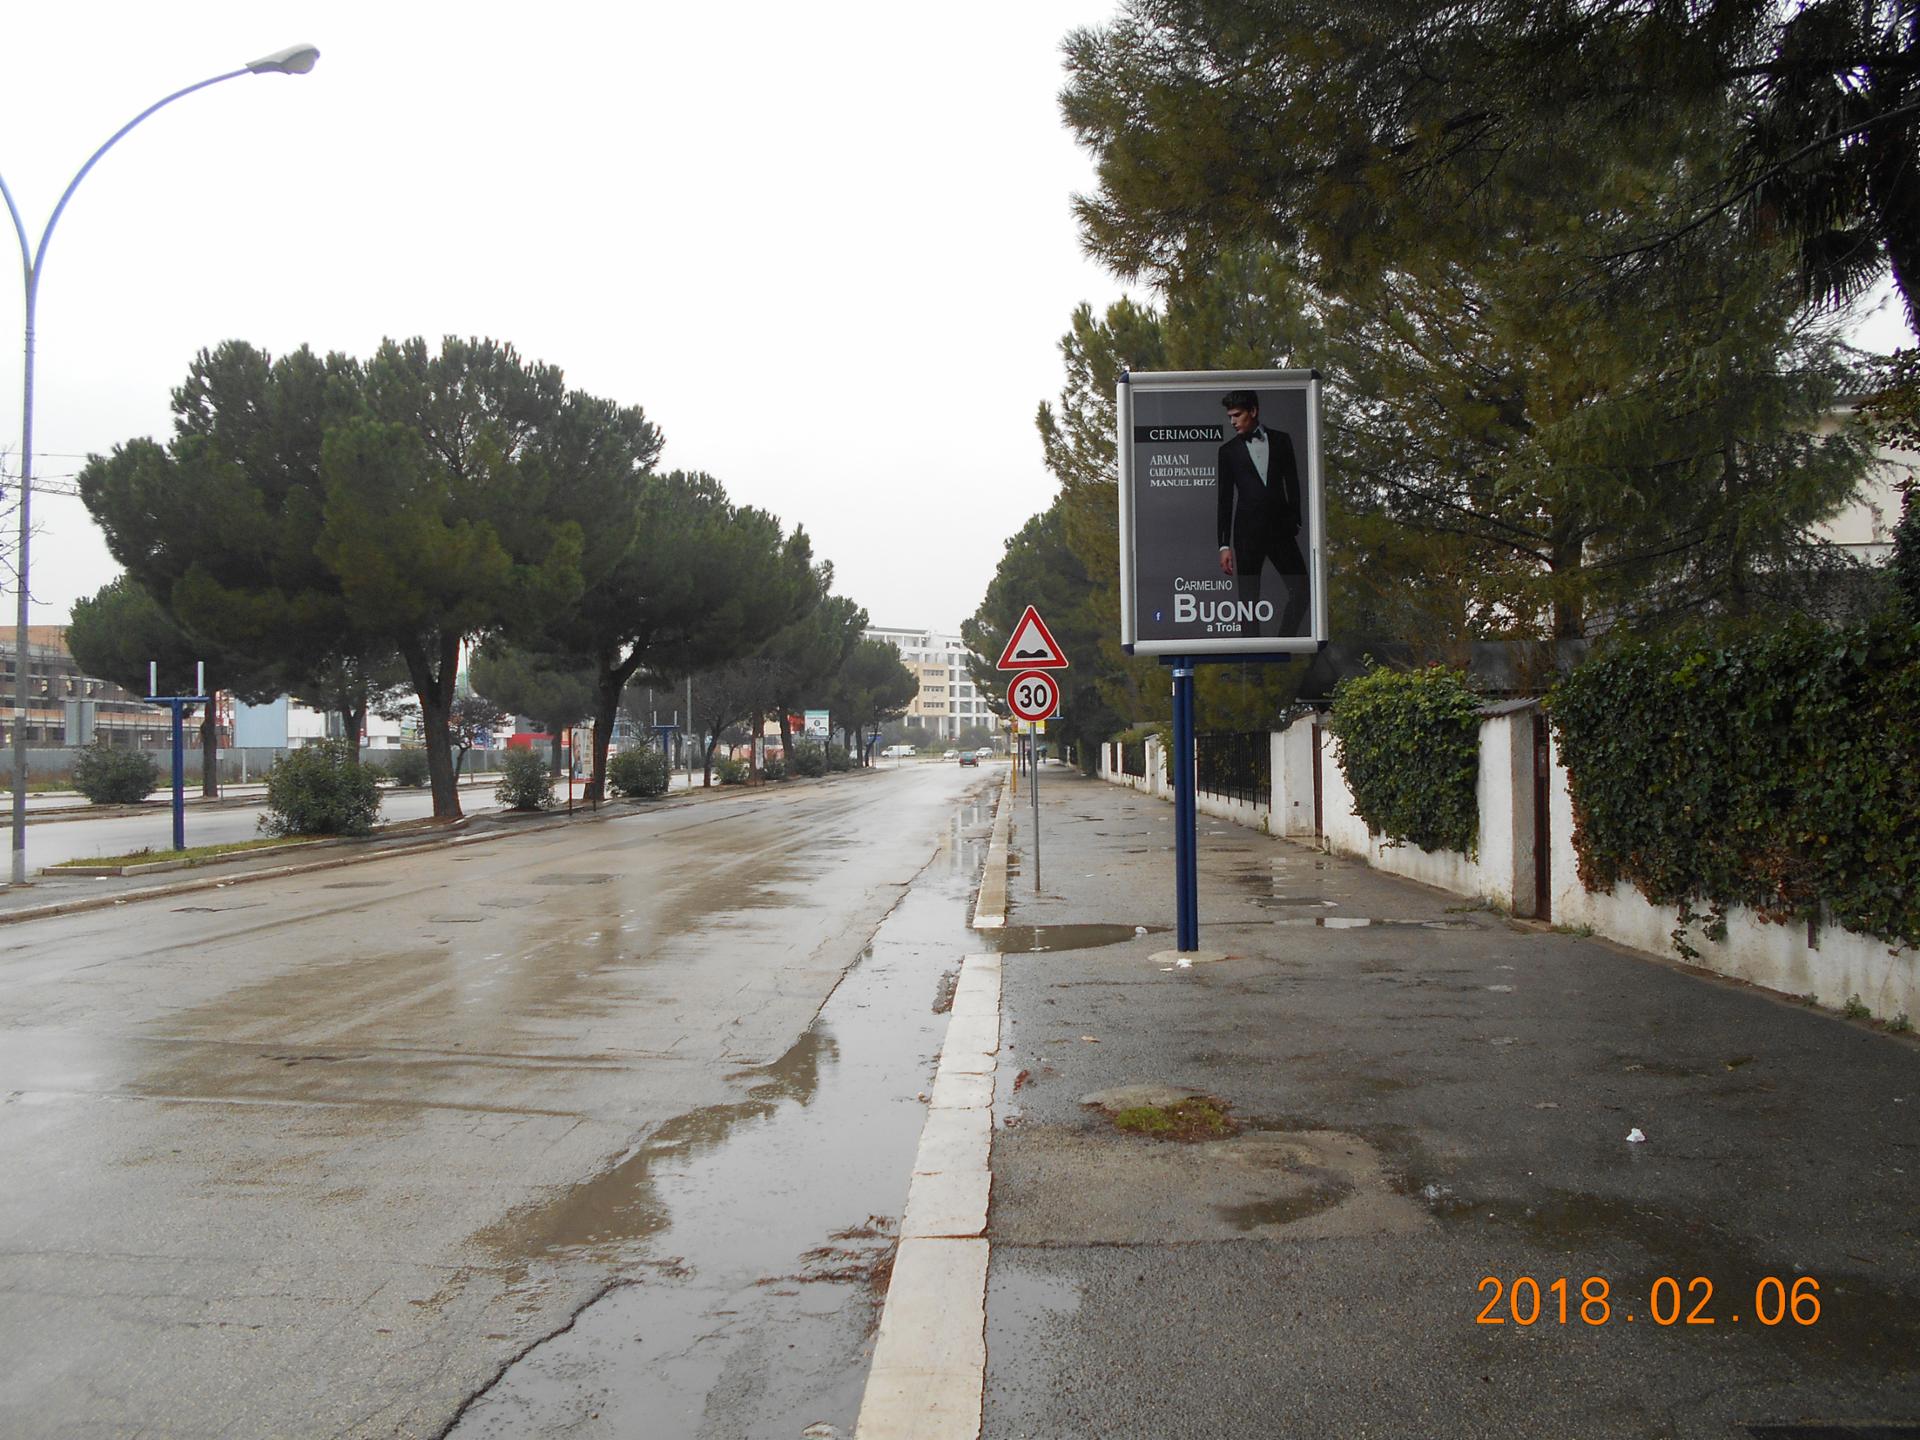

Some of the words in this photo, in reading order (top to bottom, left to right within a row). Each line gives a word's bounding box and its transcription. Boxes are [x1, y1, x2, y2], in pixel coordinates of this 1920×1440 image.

[1149, 429, 1222, 440] CERIMONIA
[1150, 455, 1189, 465] ARMANI
[1149, 467, 1173, 477] CARLO
[1174, 467, 1215, 476] PIGNATELLI
[1150, 479, 1192, 487] MANUEL
[1206, 624, 1213, 632] a
[1215, 622, 1242, 632] Troia
[1019, 684, 1047, 708] 30
